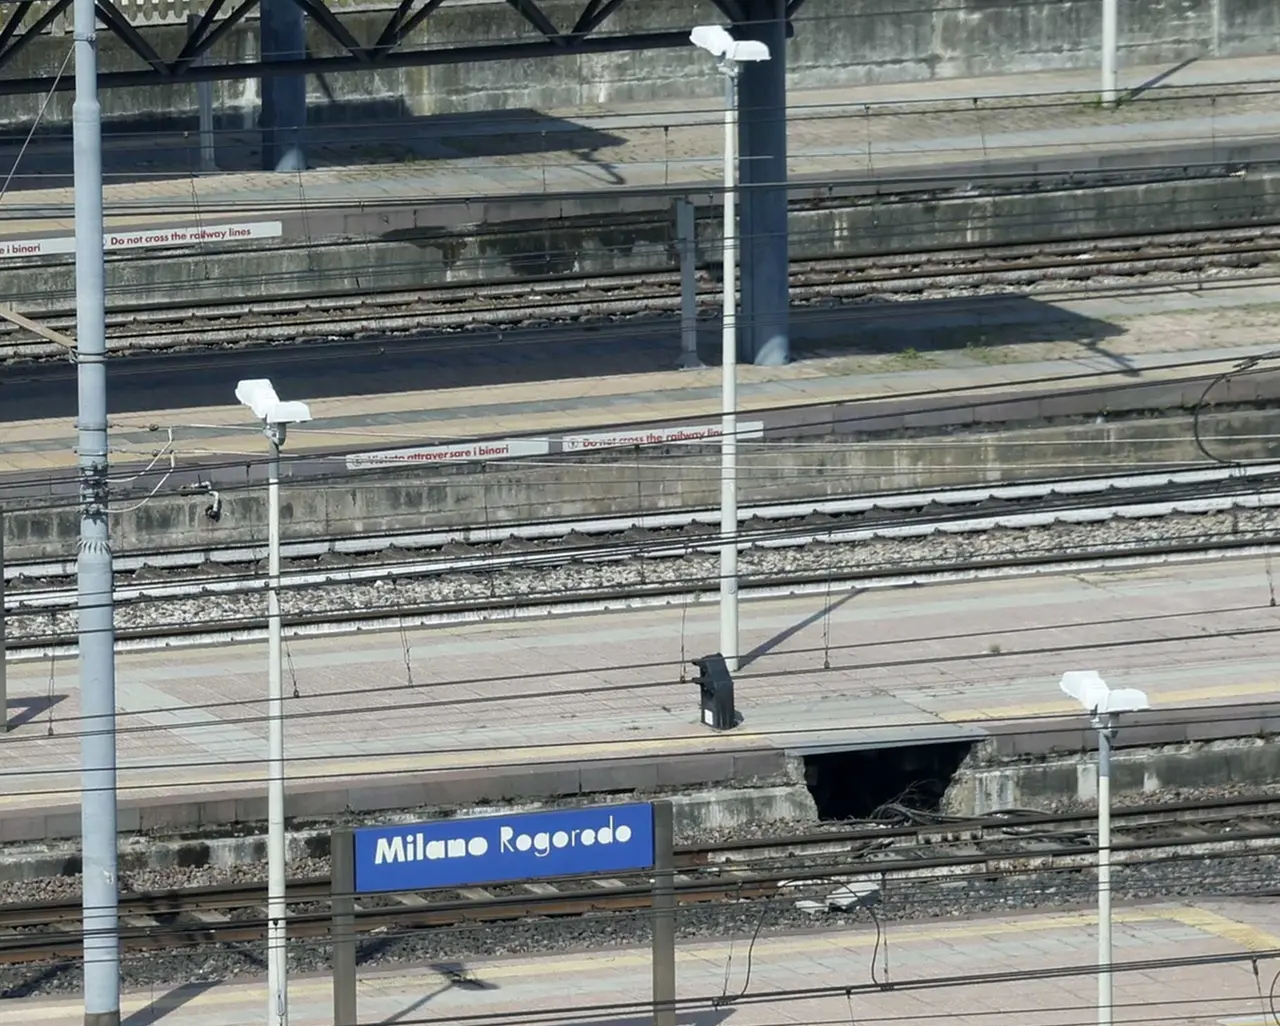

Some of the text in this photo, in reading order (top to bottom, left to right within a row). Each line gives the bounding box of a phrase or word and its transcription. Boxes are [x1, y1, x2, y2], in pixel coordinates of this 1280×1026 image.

[110, 227, 251, 246] Do not cross the railway lines
[12, 243, 41, 254] binari
[479, 444, 509, 456] binari
[375, 815, 632, 865] Milano Rogoredo
